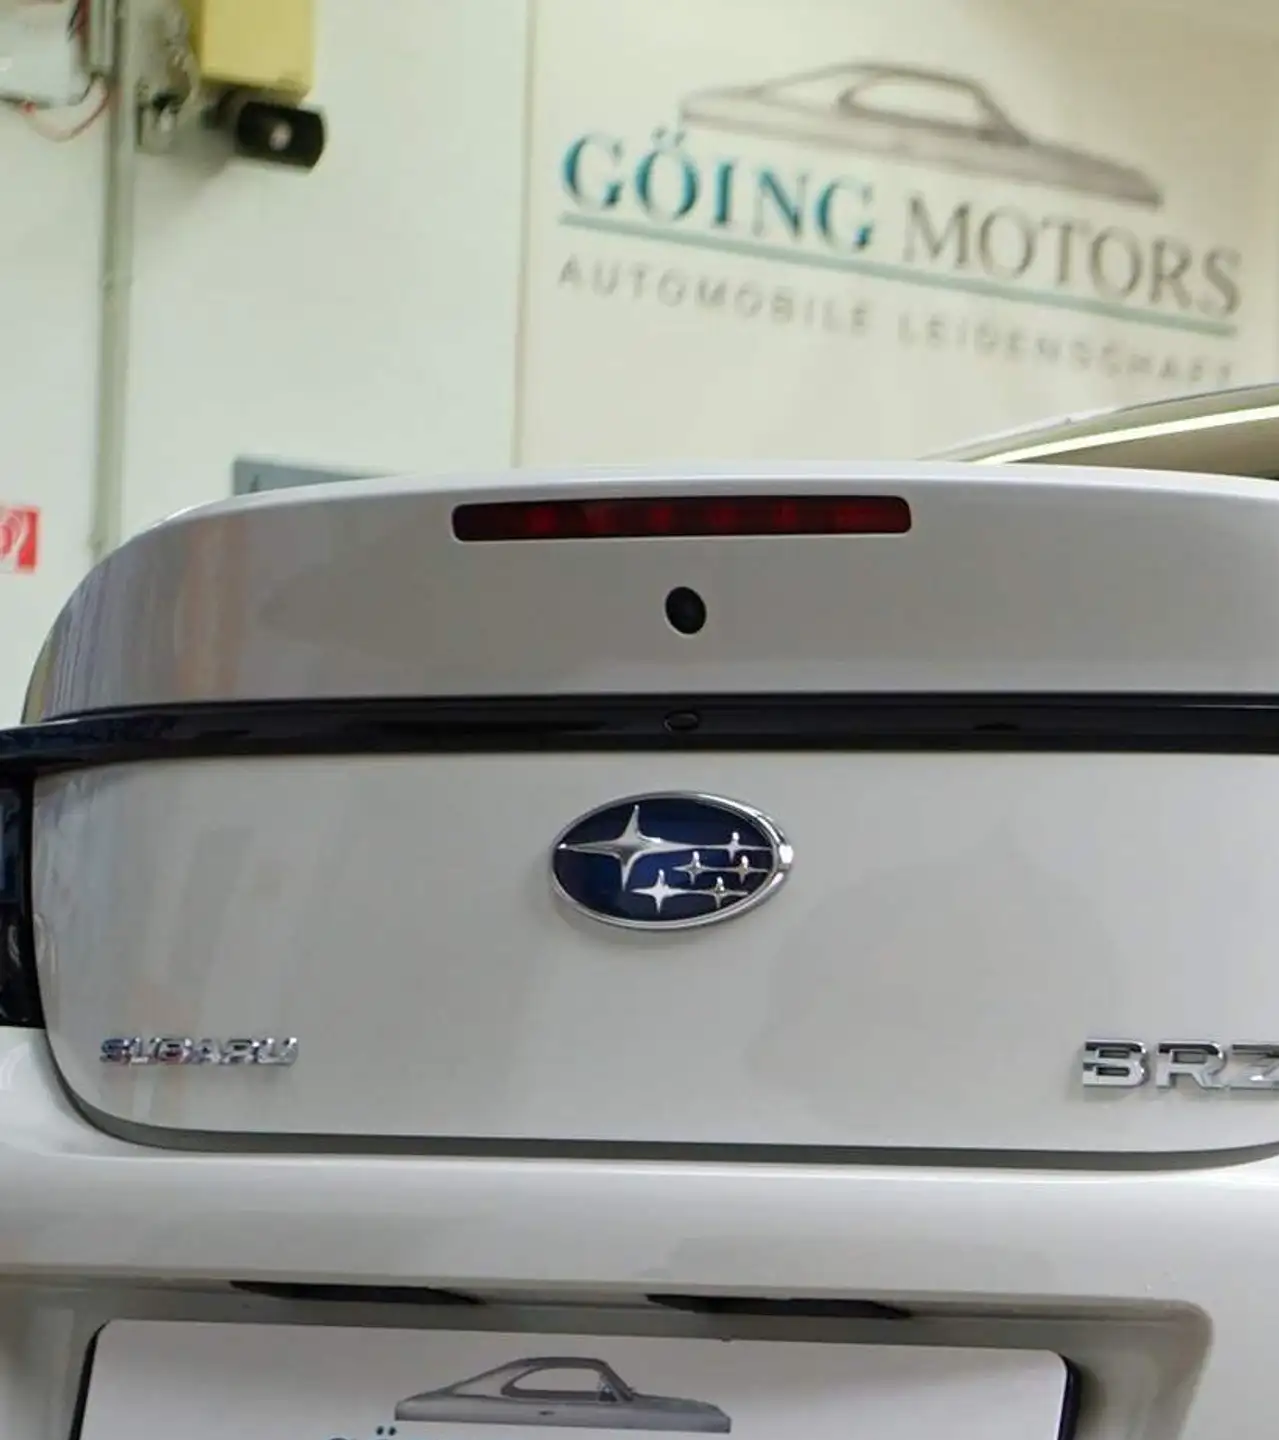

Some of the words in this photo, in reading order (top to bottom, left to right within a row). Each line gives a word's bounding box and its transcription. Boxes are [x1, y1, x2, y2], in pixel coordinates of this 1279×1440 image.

[561, 126, 874, 253] GÖING
[901, 192, 1243, 316] MOTORS
[557, 252, 869, 335] AUTOMOBILE
[100, 1036, 297, 1066] SUBARU
